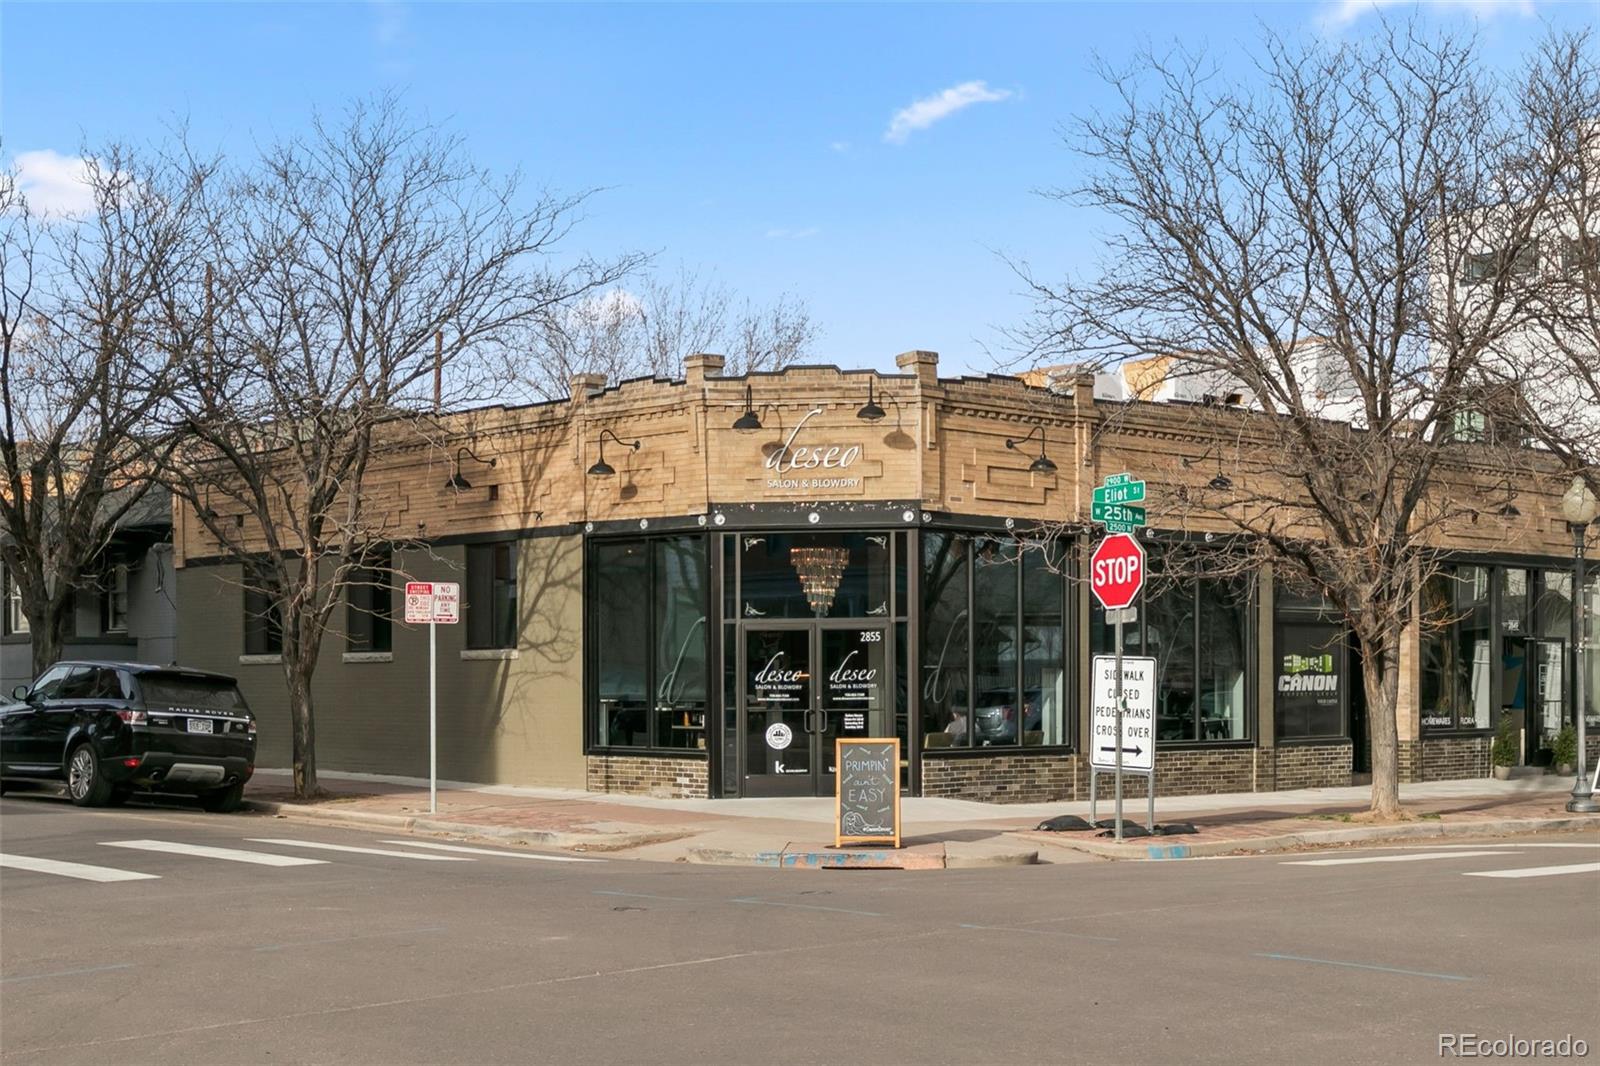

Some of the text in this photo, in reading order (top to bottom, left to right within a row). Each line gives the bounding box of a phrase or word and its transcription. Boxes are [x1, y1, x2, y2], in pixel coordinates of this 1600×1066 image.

[765, 408, 859, 473] deseo
[767, 478, 860, 488] SALON & BLOWDRY
[1105, 486, 1140, 503] Eliot St
[1104, 505, 1133, 521] 25th
[1135, 512, 1144, 521] Ave
[1109, 523, 1126, 531] 2500
[1095, 555, 1138, 587] STOP
[860, 631, 881, 642] 2855
[755, 651, 802, 684] deseo
[830, 650, 877, 683] deseo
[1104, 670, 1144, 681] SIDWALK
[1278, 673, 1338, 691] CANON
[1107, 688, 1140, 700] CLSED
[1096, 706, 1151, 720] PEDETRIANS
[1096, 725, 1150, 738] CROS OVER
[845, 758, 888, 772] PRIMPIN'
[848, 788, 886, 802] EASY
